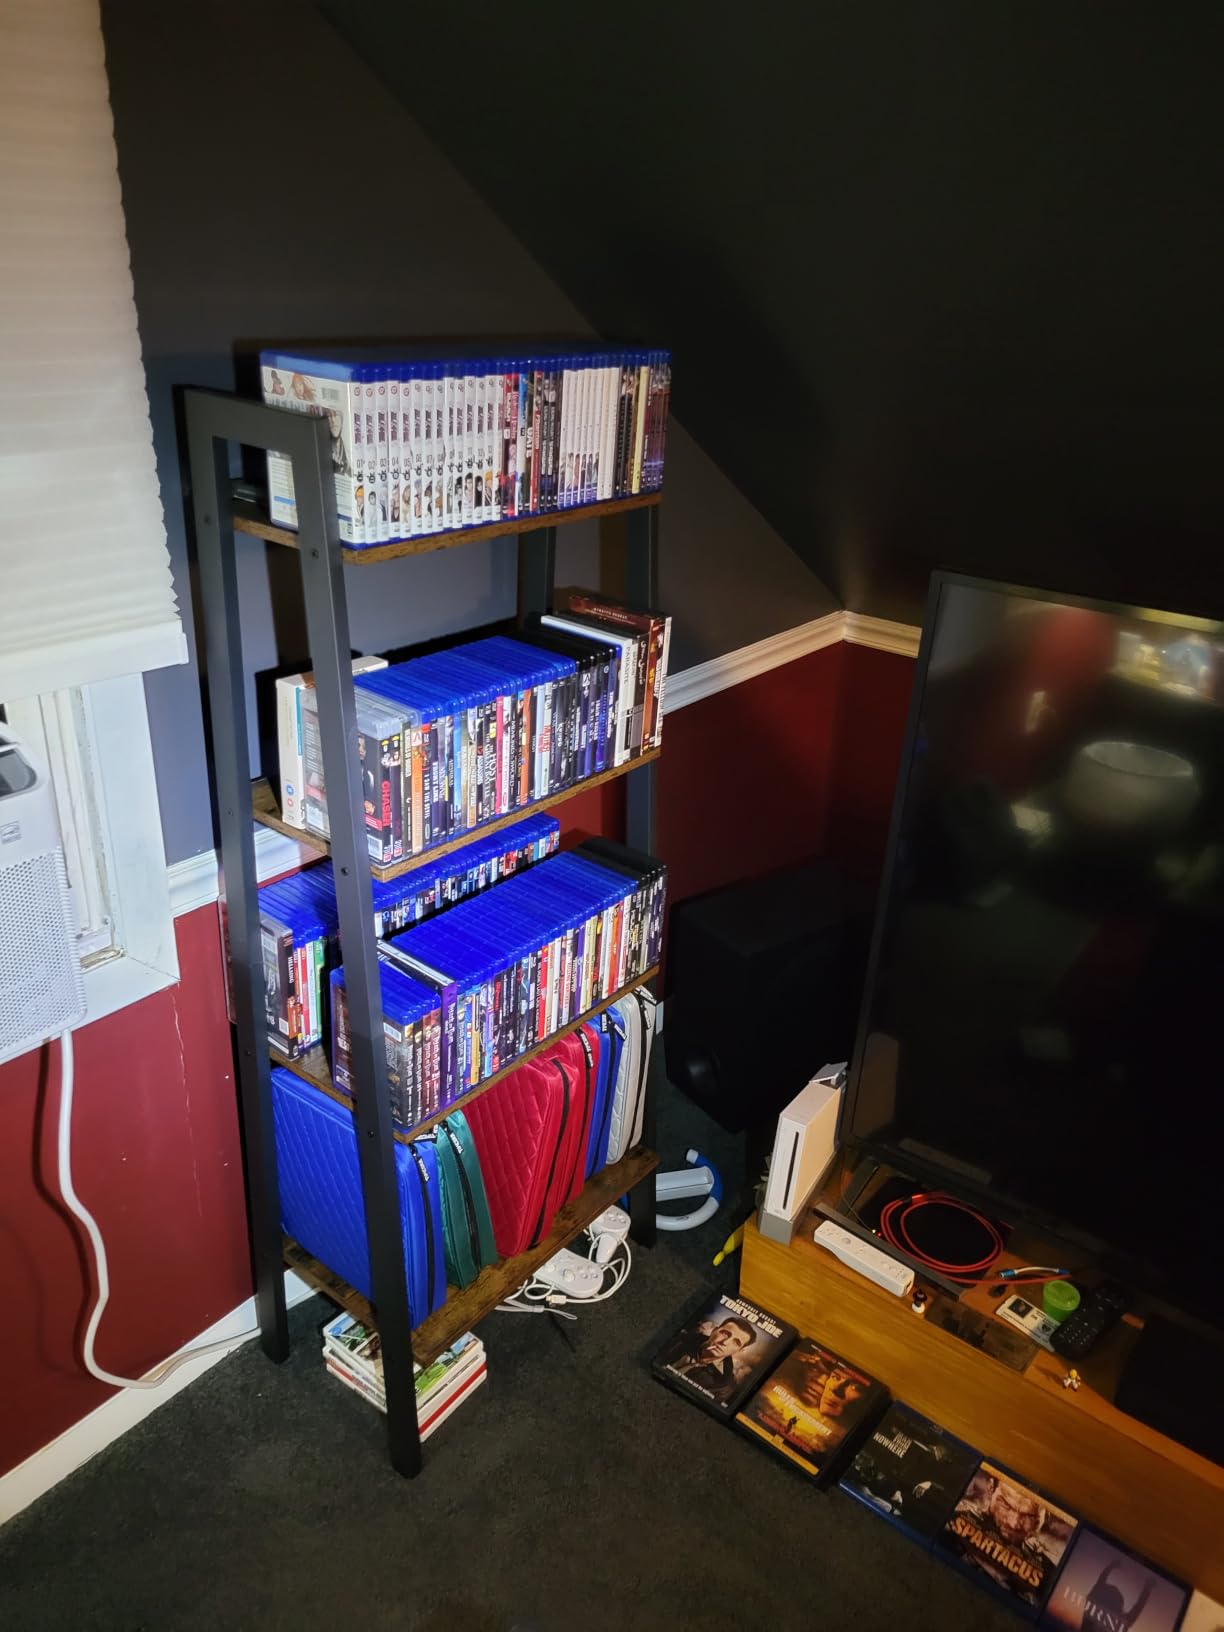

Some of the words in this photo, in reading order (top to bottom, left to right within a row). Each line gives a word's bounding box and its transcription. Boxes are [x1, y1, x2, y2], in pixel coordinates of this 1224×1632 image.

[382, 781, 391, 827] CHASER
[720, 1294, 759, 1324] TOKYO
[756, 1318, 783, 1338] JOE
[873, 1431, 907, 1459] NOWHERE
[952, 1519, 1045, 1587] SPARTACUS
